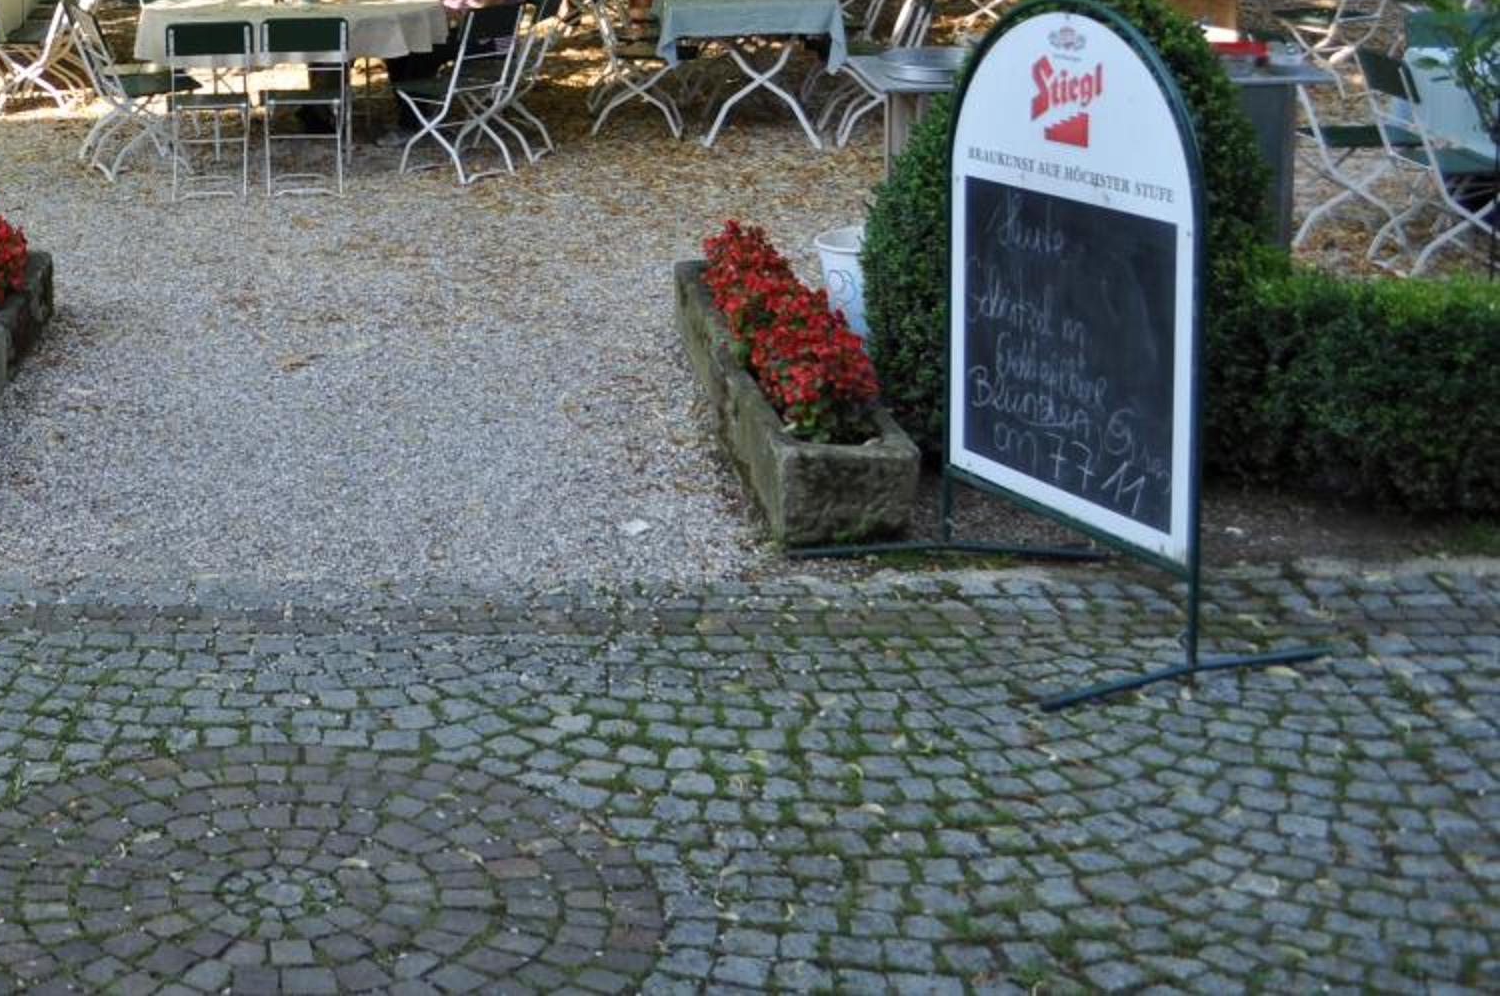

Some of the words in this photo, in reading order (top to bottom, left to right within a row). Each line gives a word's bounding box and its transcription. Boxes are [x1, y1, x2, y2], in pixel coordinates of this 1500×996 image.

[1030, 54, 1104, 122] Stiegl
[966, 146, 1036, 174] BRAUKUNST
[1037, 160, 1061, 179] AUF
[1064, 165, 1132, 195] HÖCHSTER
[1134, 181, 1175, 204] STUFE
